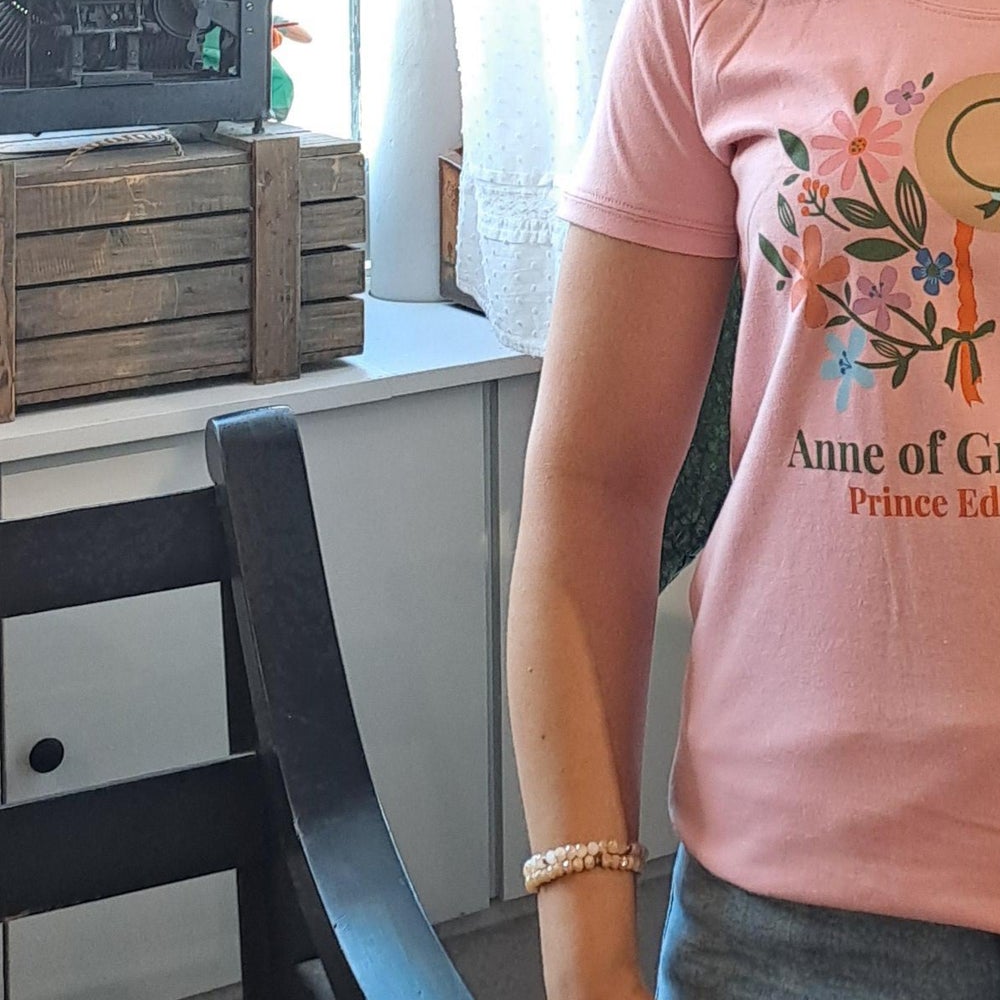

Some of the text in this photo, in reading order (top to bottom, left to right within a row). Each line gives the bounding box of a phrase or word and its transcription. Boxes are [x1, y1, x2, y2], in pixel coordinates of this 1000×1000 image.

[788, 429, 884, 475] Anne
[899, 431, 946, 475] of
[848, 485, 948, 518] Prince
